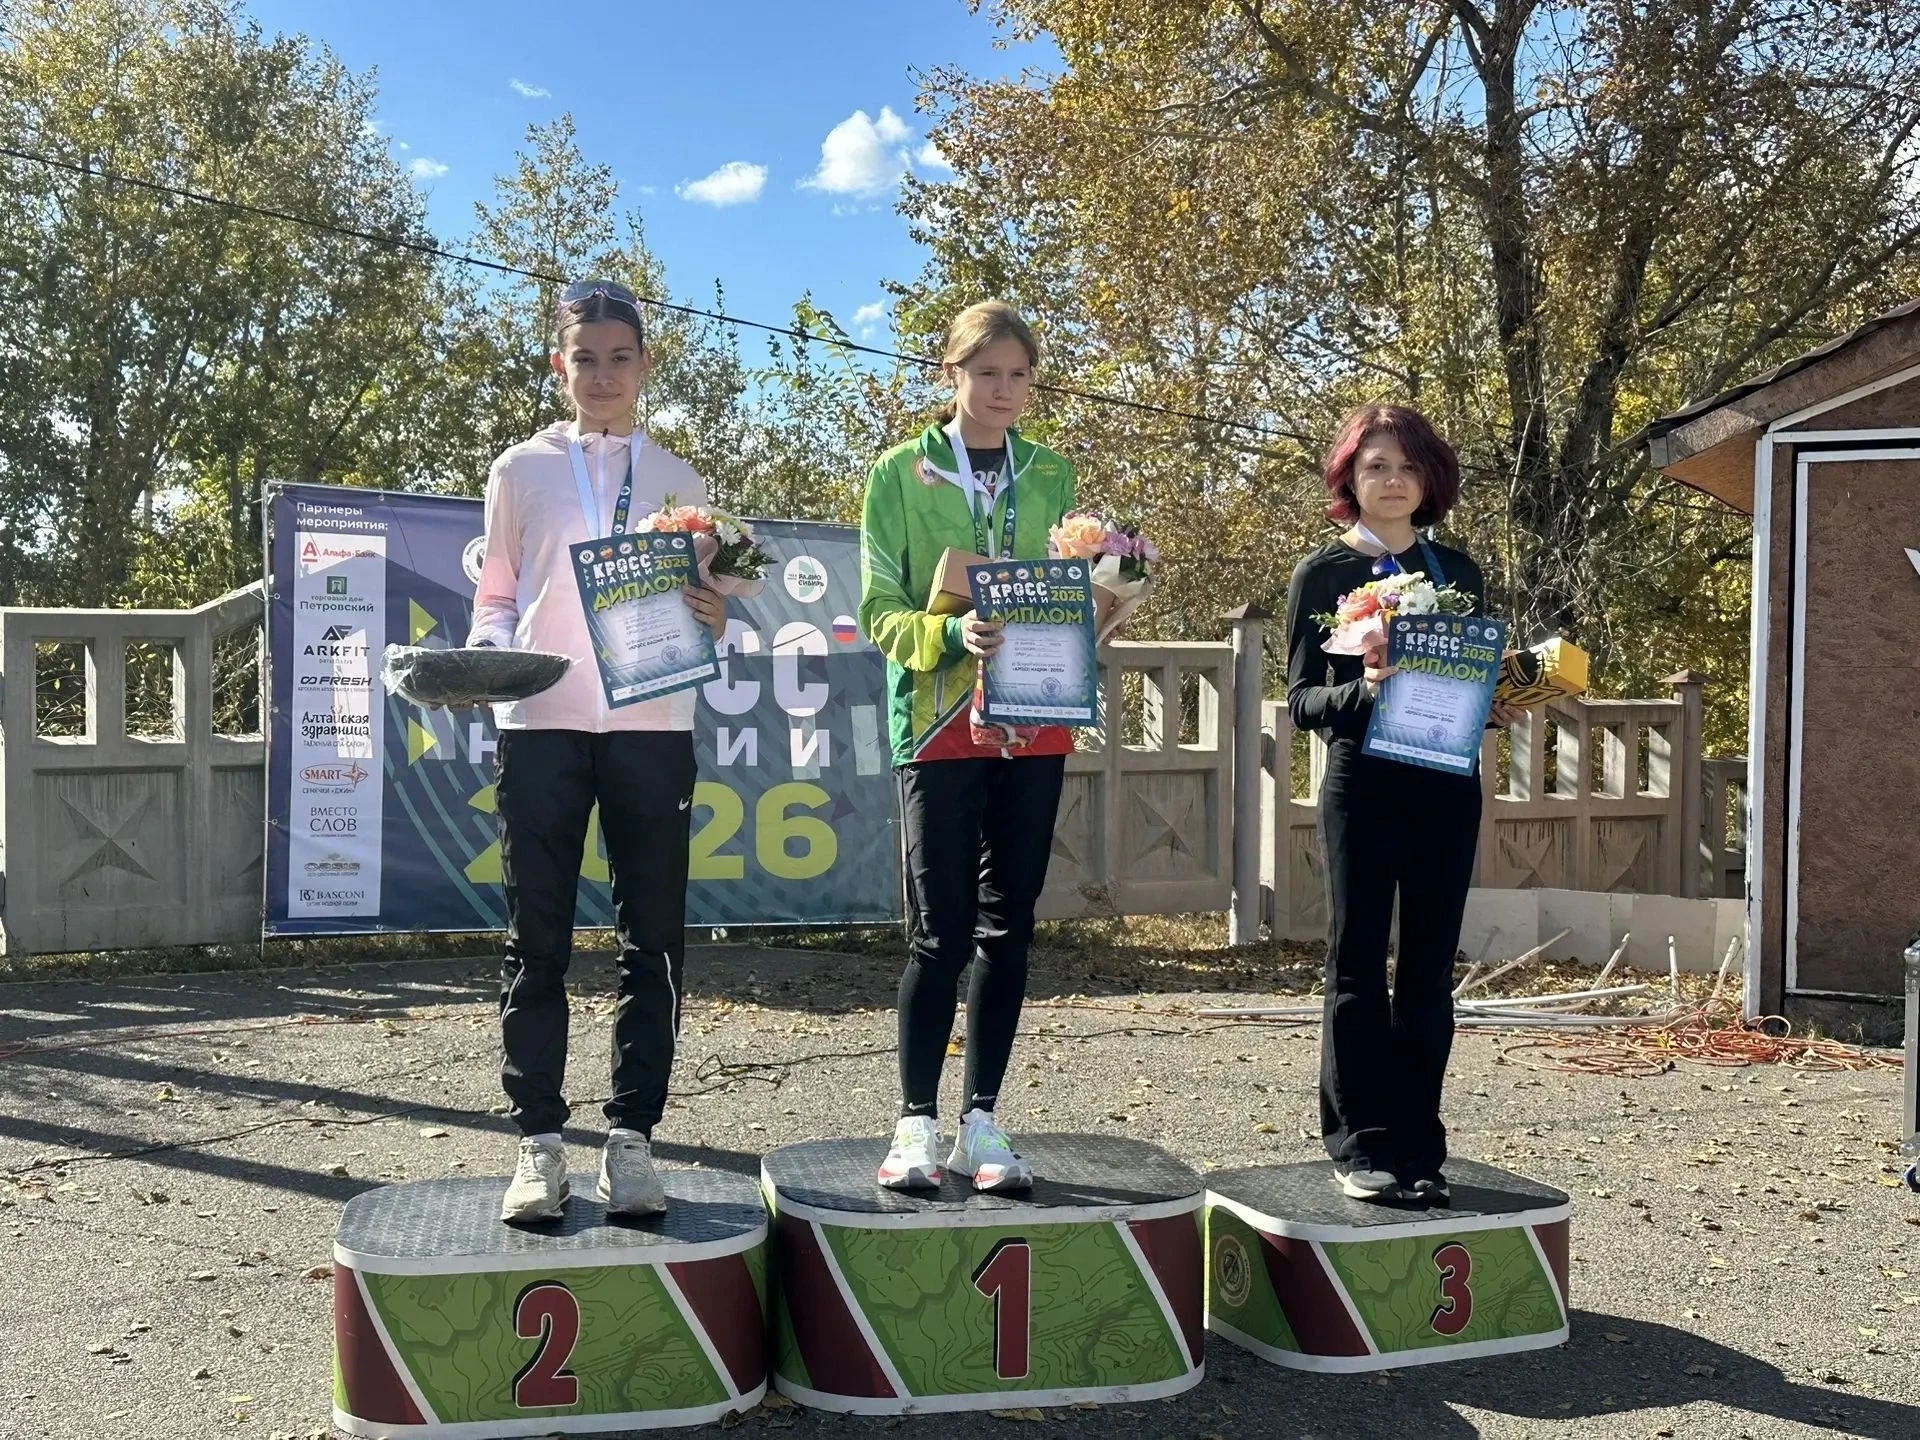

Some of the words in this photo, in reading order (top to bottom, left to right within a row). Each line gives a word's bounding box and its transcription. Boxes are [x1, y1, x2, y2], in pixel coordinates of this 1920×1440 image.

[297, 503, 363, 517] Партнеры
[297, 518, 389, 531] мероприятия:
[592, 553, 652, 580] КРОСС
[655, 557, 691, 570] 2026
[596, 567, 653, 587] НАЦИИ
[593, 573, 690, 613] ДИПЛОМ
[989, 581, 1048, 598] КРОСС
[1050, 589, 1086, 602] 2026
[300, 601, 374, 612] Петровский
[991, 596, 1049, 605] НАЦИИ
[989, 606, 1084, 626] ДИПЛОМ
[1405, 632, 1461, 651] КРОСС
[304, 645, 370, 657] ARKFIT
[1404, 644, 1460, 659] НАЦИИ
[1462, 648, 1496, 662] 2026
[1394, 654, 1489, 684] ДИПЛОМ
[302, 708, 370, 724] Алтайская
[301, 725, 370, 739] здравница
[304, 769, 342, 780] SMART
[311, 807, 357, 816] ВМЕСТО
[310, 818, 357, 831] СЛОВ
[317, 890, 365, 899] BASCONI
[1430, 1242, 1473, 1336] 3
[972, 1237, 1031, 1379] 1
[513, 1281, 580, 1408] 2
